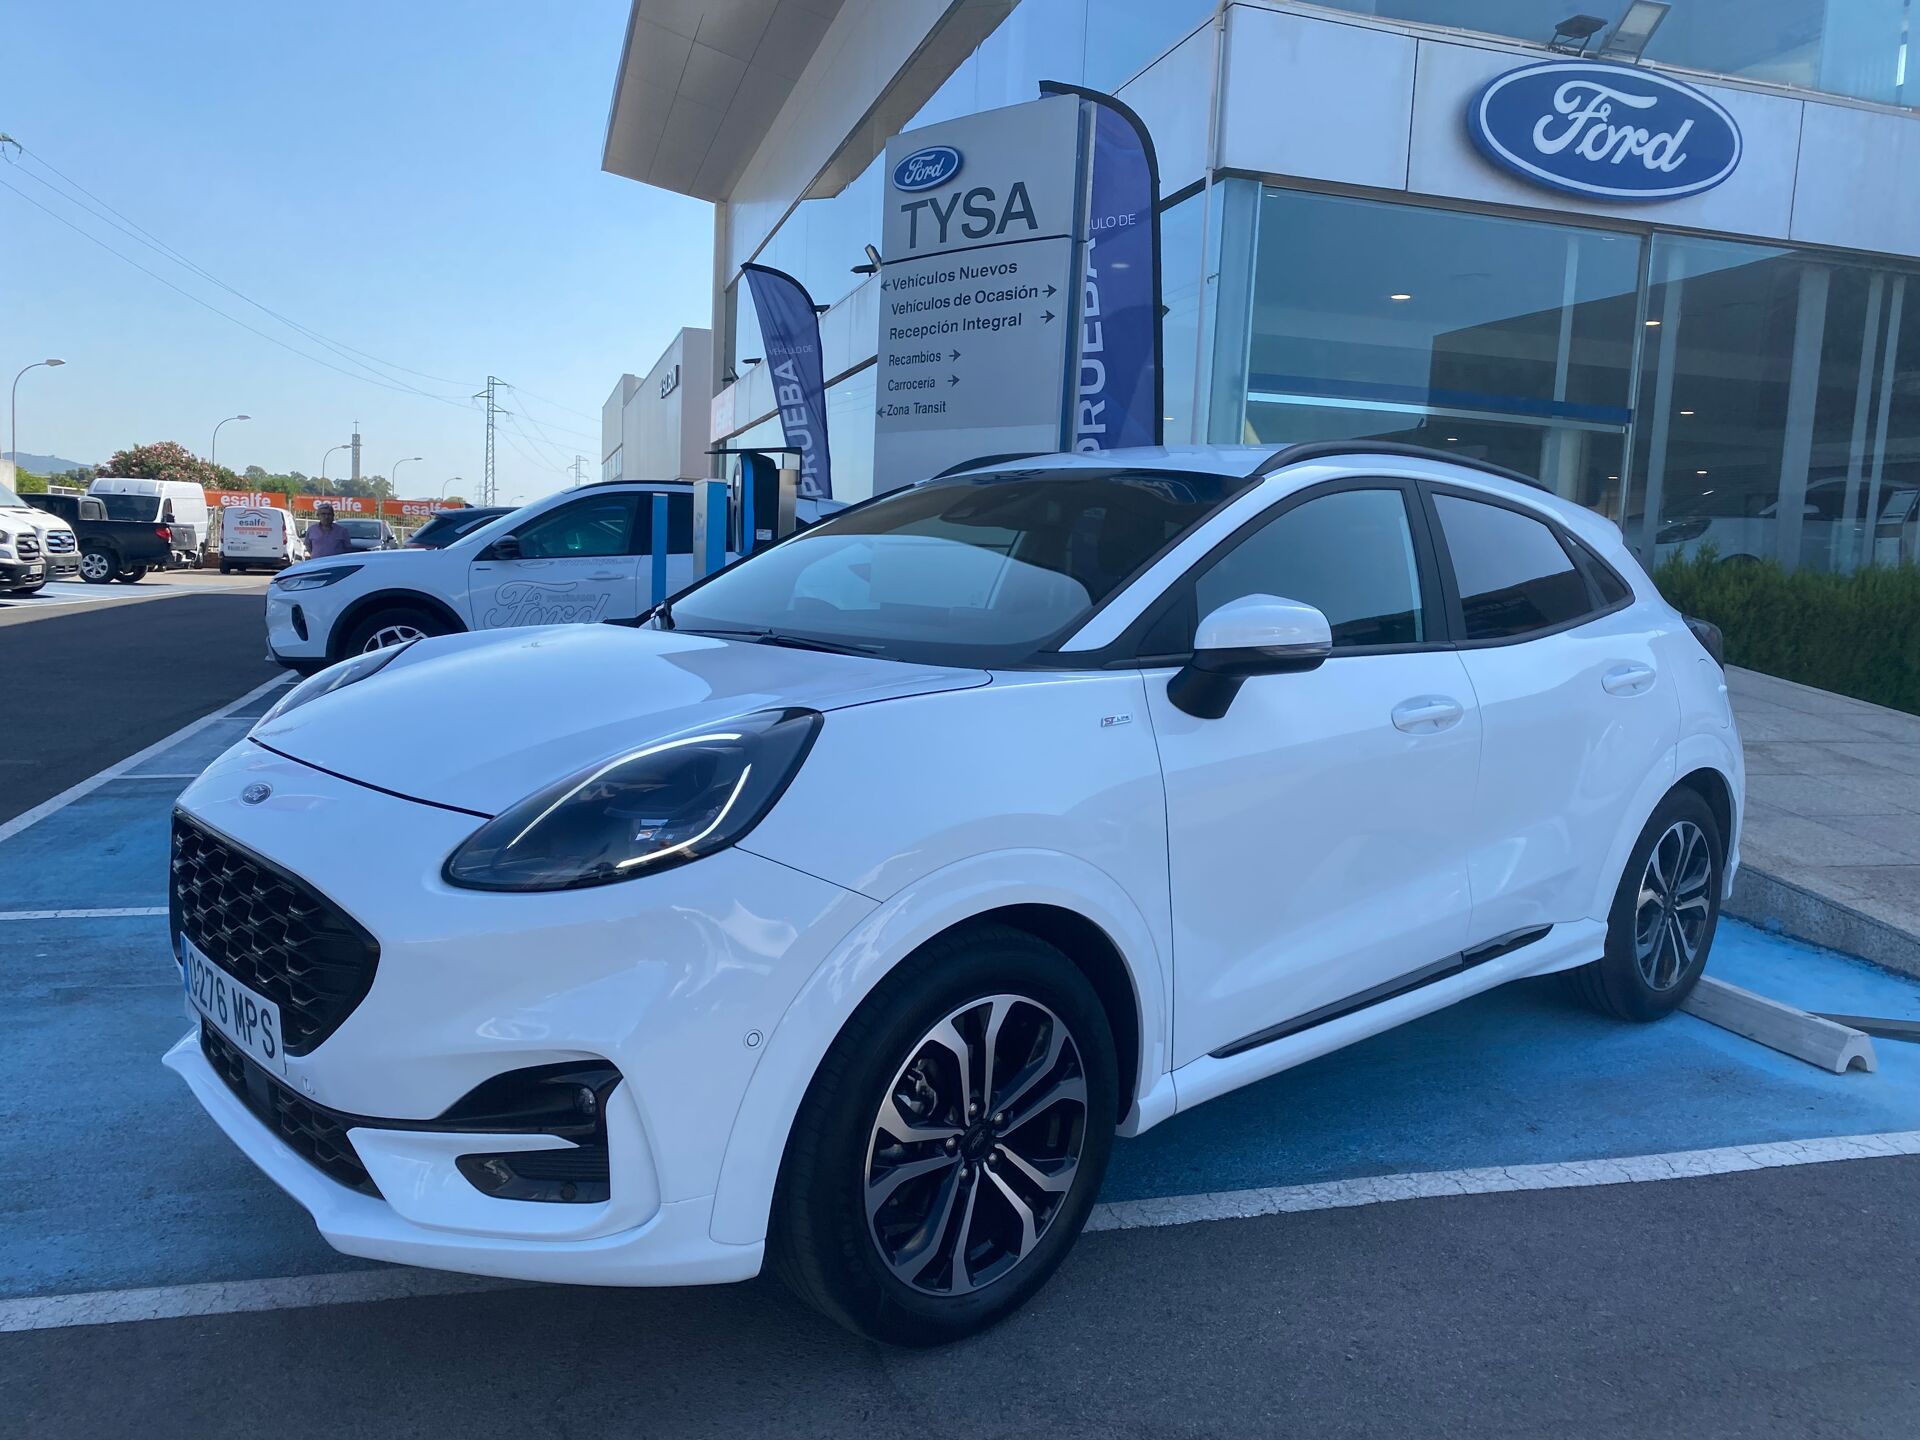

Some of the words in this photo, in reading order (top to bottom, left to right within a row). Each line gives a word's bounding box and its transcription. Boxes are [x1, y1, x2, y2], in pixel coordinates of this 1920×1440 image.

[1533, 80, 1695, 173] Ford
[904, 154, 946, 184] Ford
[901, 181, 1039, 249] TYSA
[1089, 216, 1117, 230] ULO
[1119, 213, 1136, 226] DE
[892, 270, 956, 291] Vehículos
[959, 262, 1018, 281] Nuevos
[891, 295, 950, 316] Vehículos
[953, 293, 972, 307] de
[975, 285, 1038, 304] Ocasión
[889, 320, 958, 341] Recepción
[962, 312, 1022, 332] Integral
[888, 350, 942, 367] Recambios
[886, 404, 910, 417] Zona
[913, 400, 947, 415] Transit
[774, 358, 823, 497] PRUEBA
[220, 492, 271, 508] esalfe
[401, 502, 448, 516] esalf
[239, 518, 266, 527] esalfe
[483, 579, 611, 627] Ford
[189, 951, 228, 1025] 0276
[231, 986, 276, 1059] MPS
